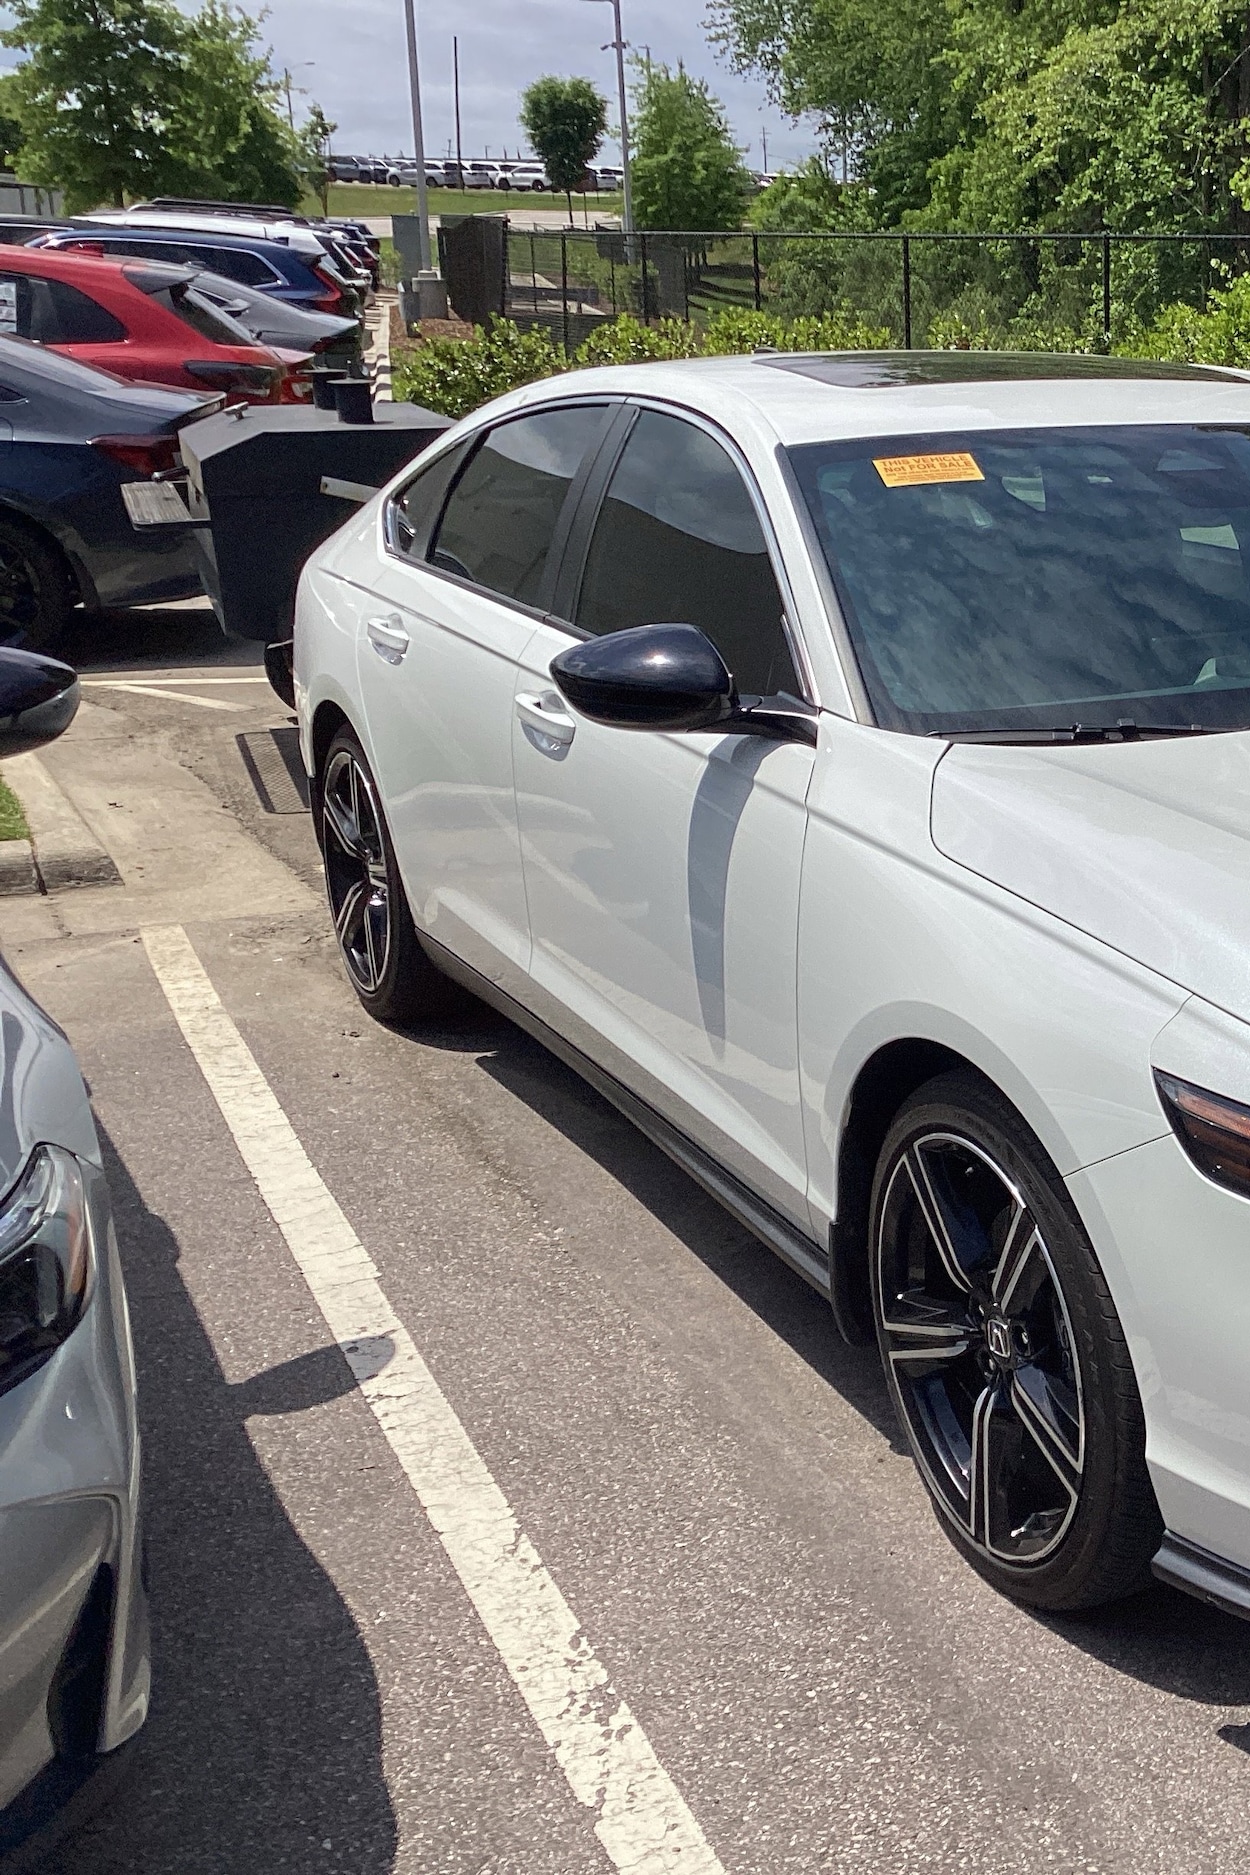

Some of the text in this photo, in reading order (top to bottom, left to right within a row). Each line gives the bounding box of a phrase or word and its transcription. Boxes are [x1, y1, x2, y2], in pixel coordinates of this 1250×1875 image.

[881, 455, 968, 467] THIS VEHICLE
[909, 463, 937, 471] FOR
[939, 460, 973, 468] SALE
